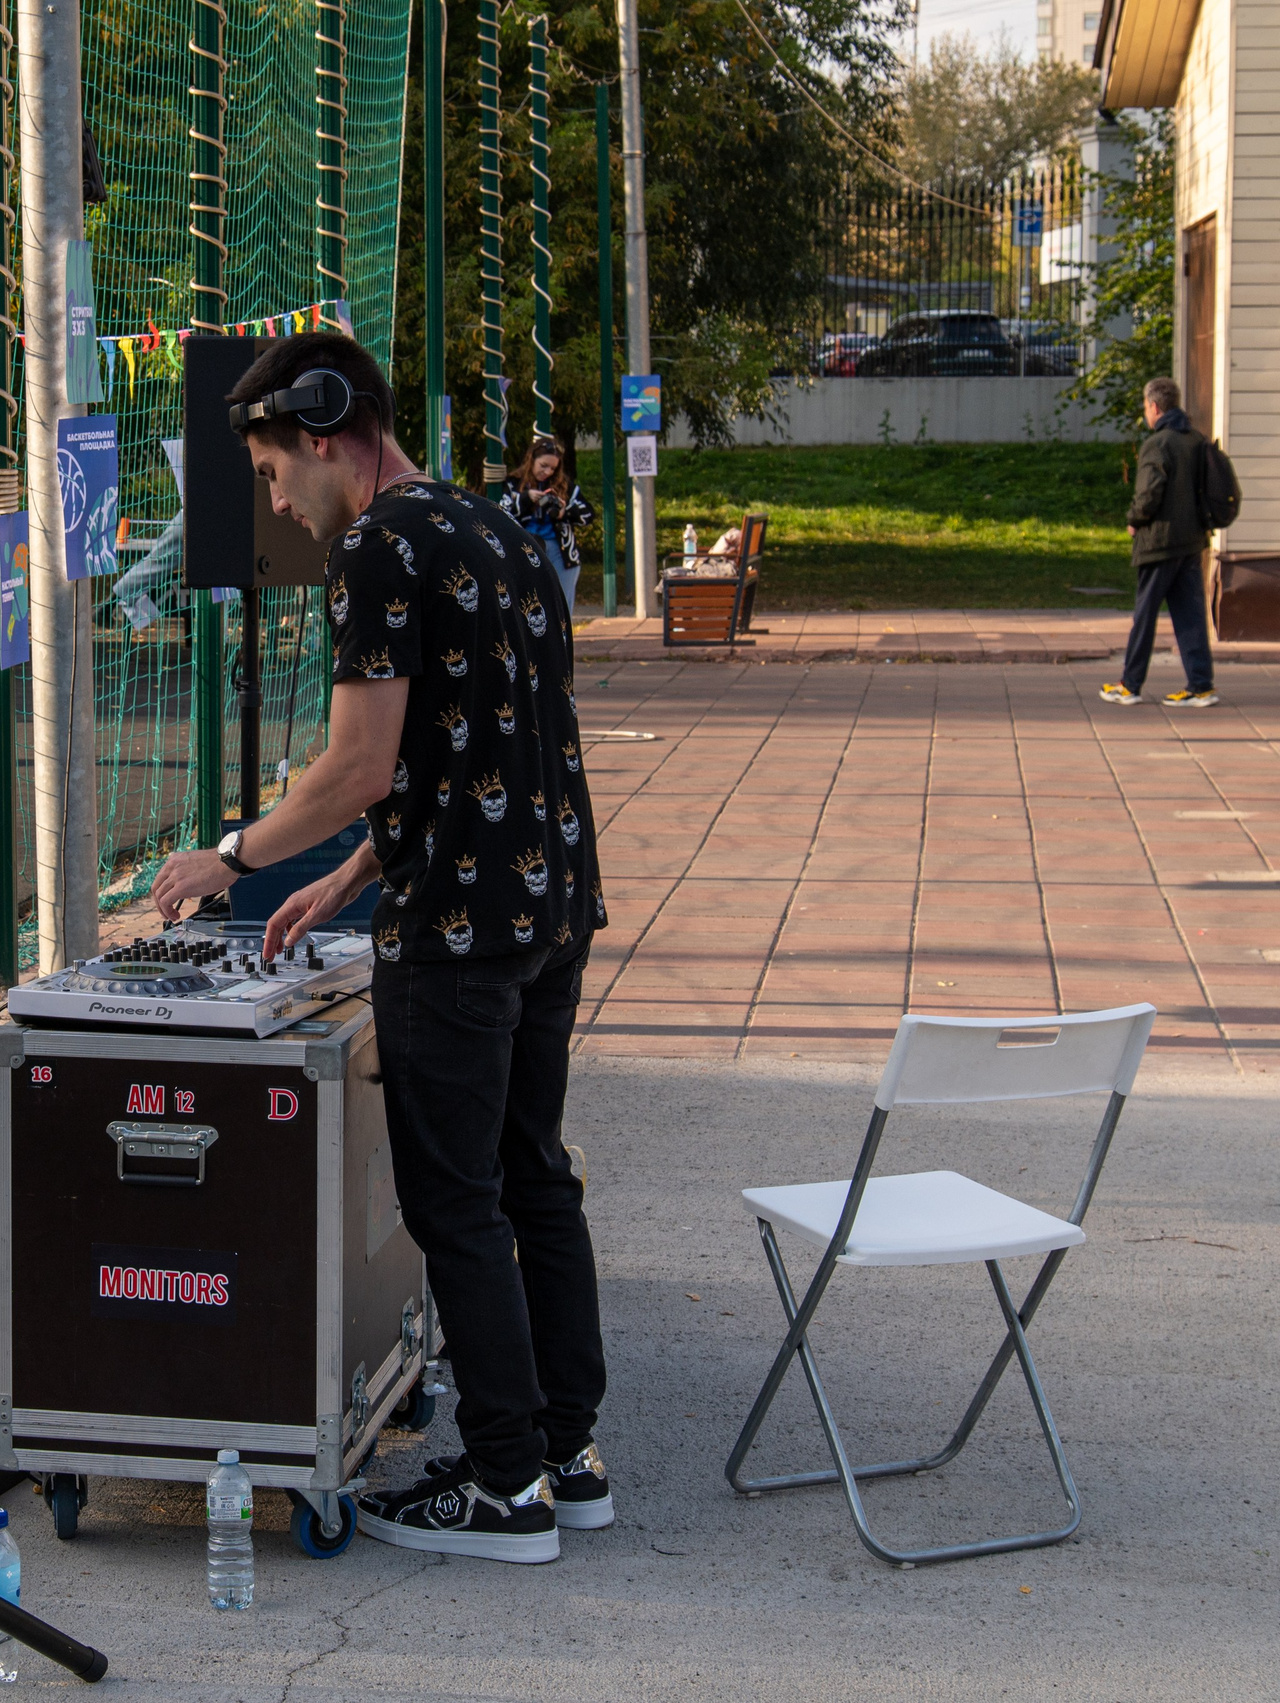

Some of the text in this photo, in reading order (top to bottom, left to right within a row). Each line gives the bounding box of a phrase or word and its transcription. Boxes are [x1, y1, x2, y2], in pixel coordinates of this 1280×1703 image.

[67, 430, 114, 441] БАСКЕТБОЛЬНАЯ
[80, 440, 115, 450] ПЛОЩАДКА
[88, 1002, 152, 1016] Pioneer
[31, 1066, 52, 1082] 16
[126, 1084, 195, 1115] AM 12
[268, 1088, 298, 1120] D
[99, 1265, 229, 1305] MONITORS
